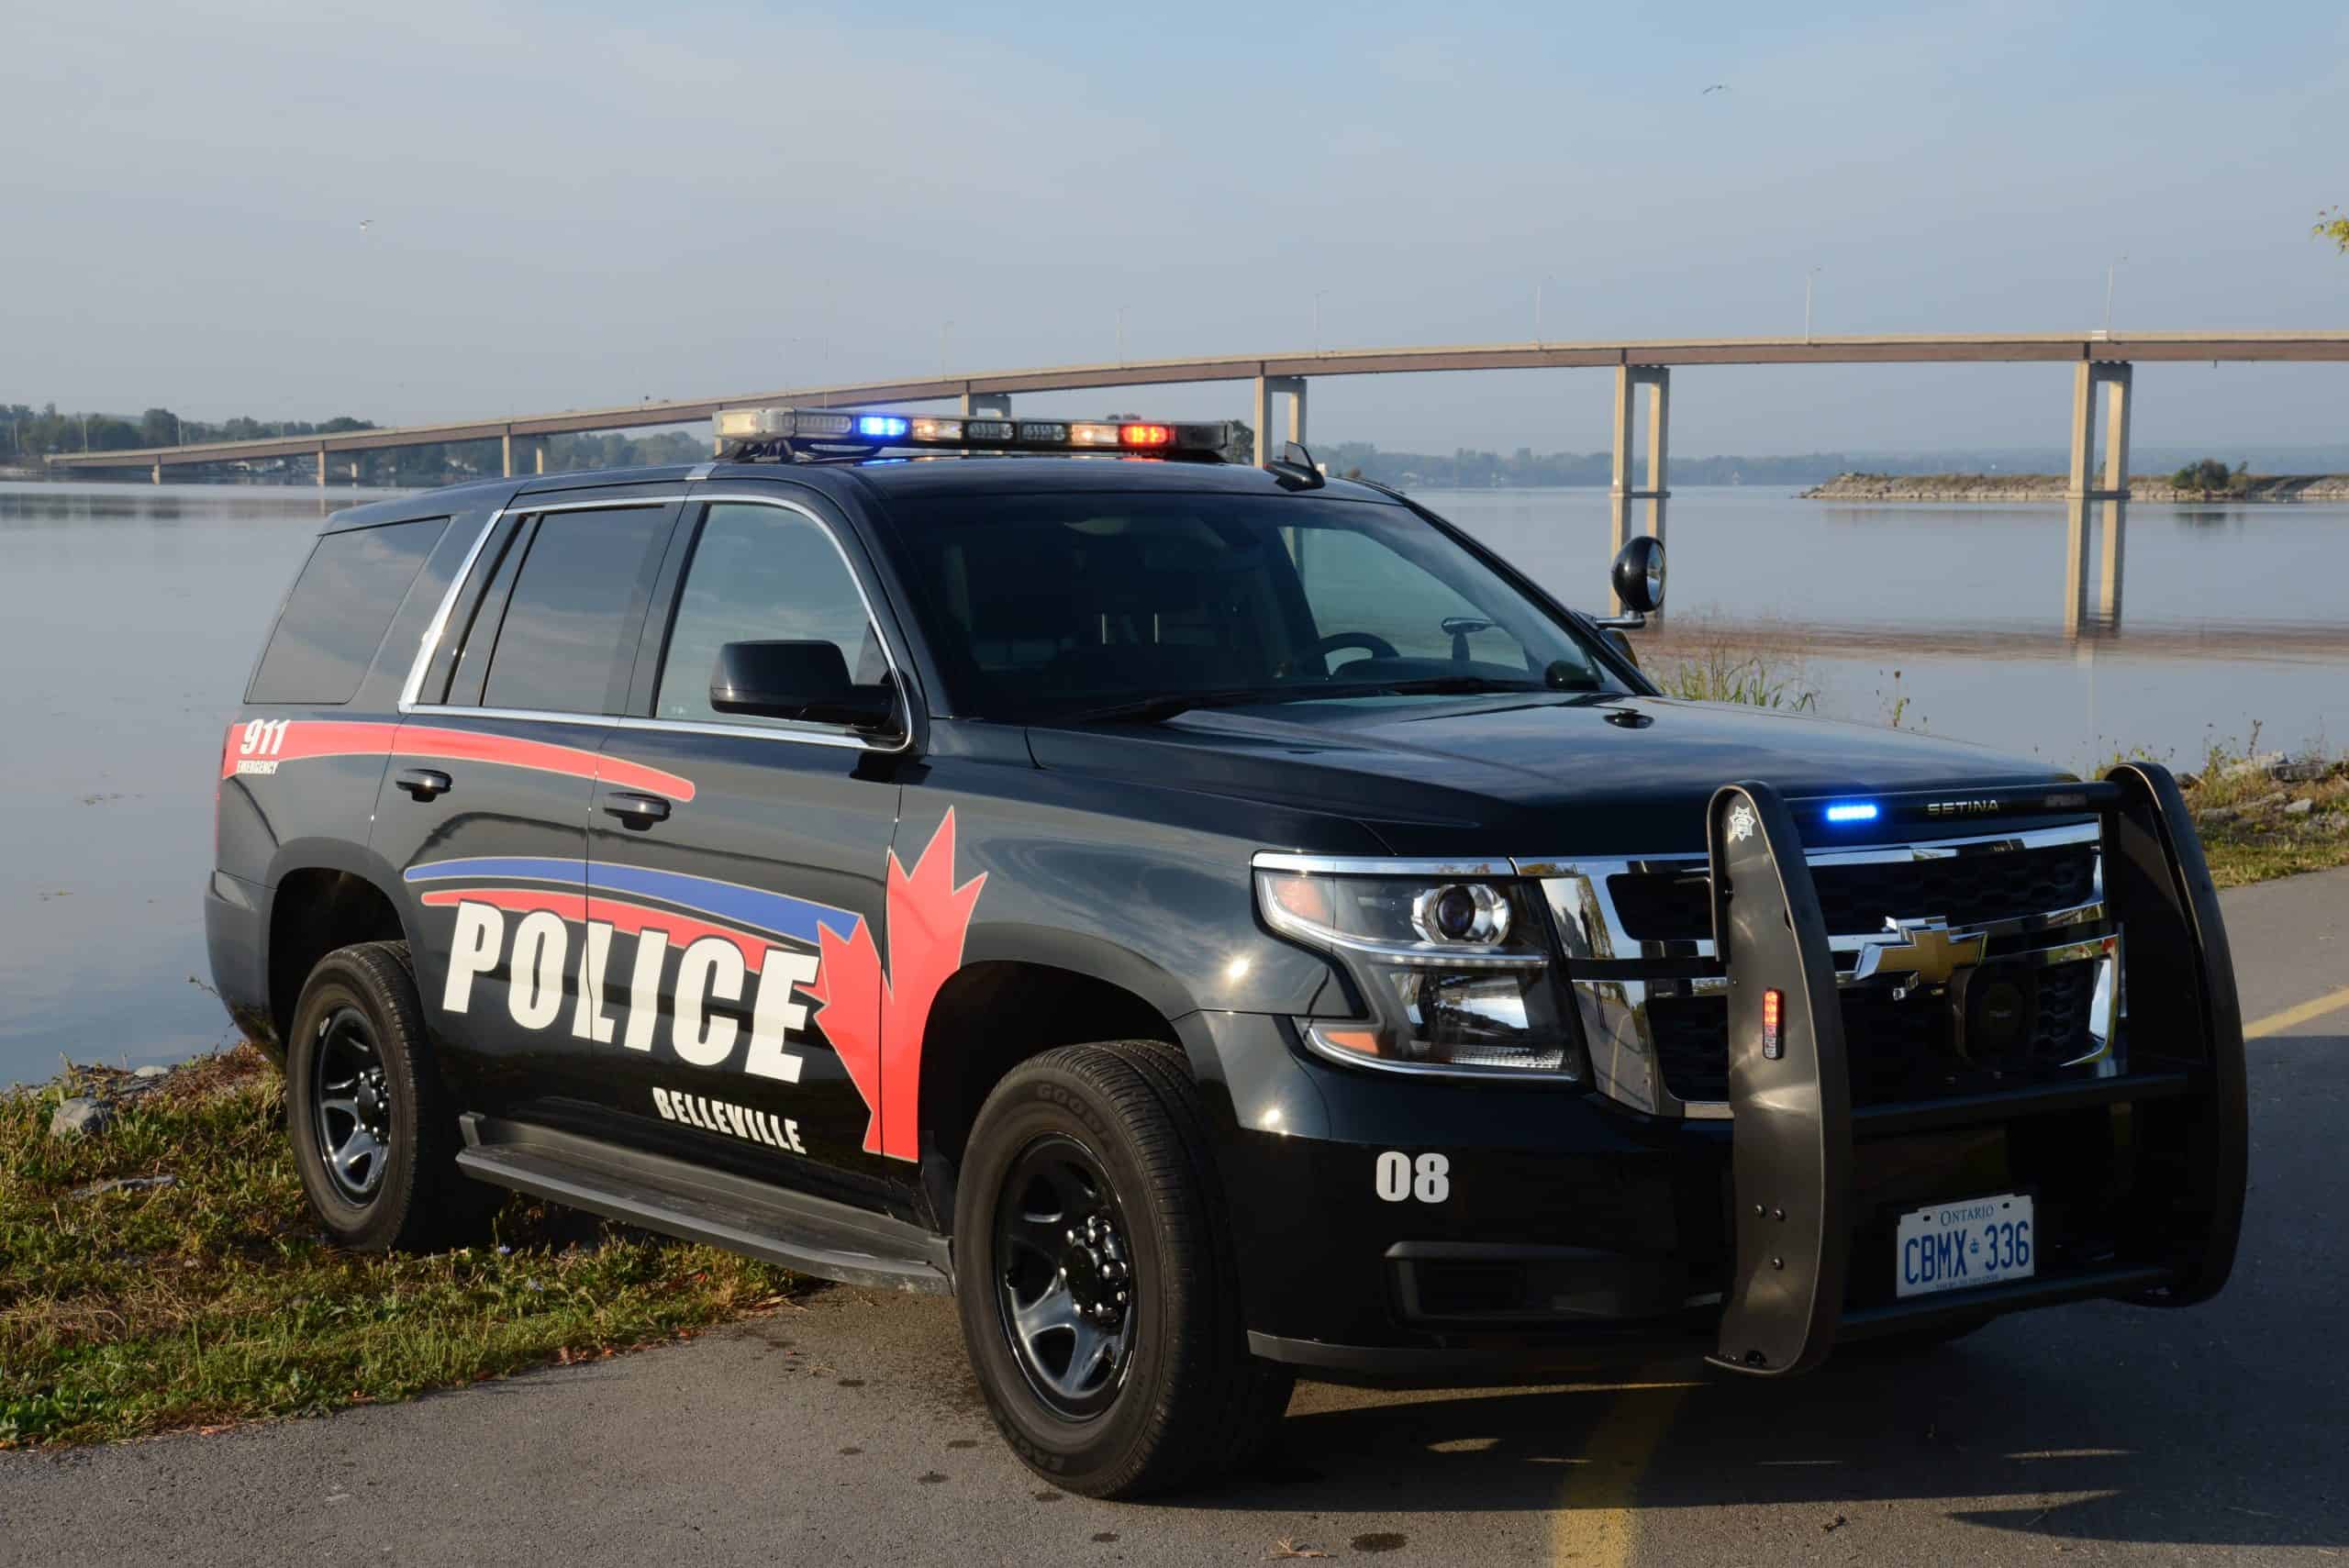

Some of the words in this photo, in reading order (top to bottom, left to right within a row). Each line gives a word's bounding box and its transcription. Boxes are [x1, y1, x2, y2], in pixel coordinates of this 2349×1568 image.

[239, 719, 291, 754] 911
[1927, 799, 1998, 815] SETINA
[443, 899, 820, 1083] POLICE
[652, 1087, 807, 1154] BELLEVILLE
[1376, 1151, 1450, 1203] 08
[1905, 1229, 1967, 1284] CBMX
[1985, 1220, 2029, 1271] 336
